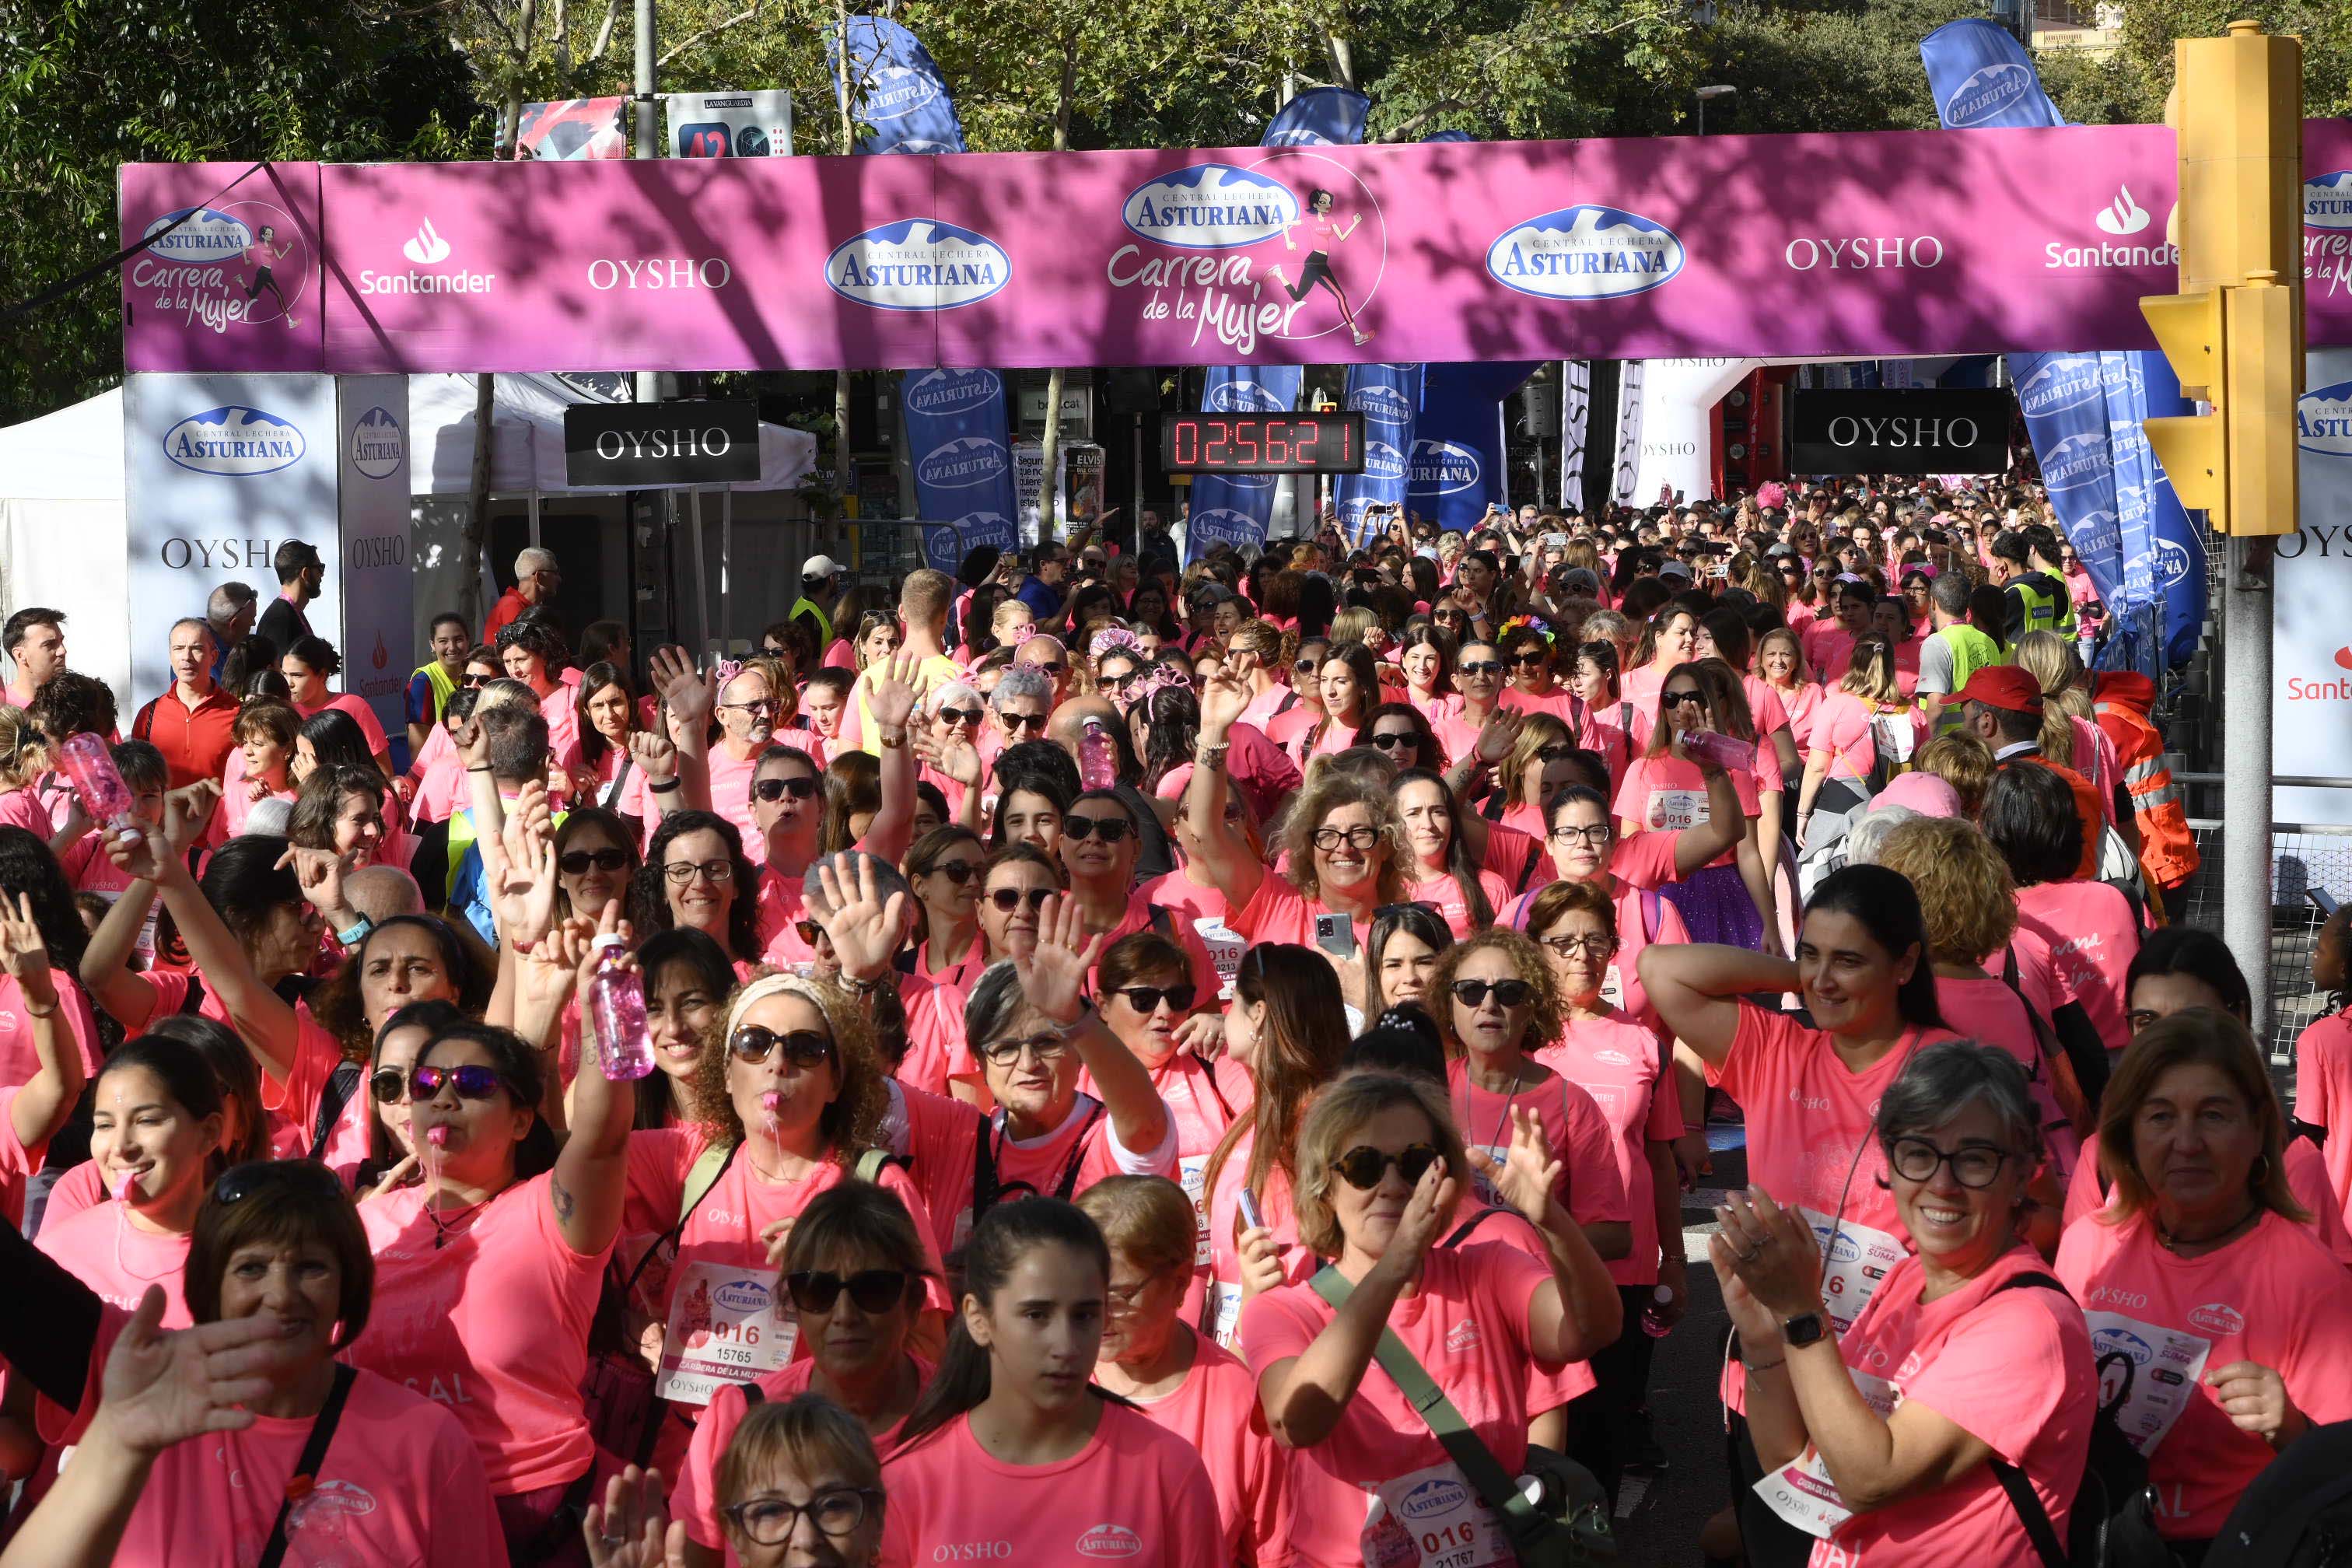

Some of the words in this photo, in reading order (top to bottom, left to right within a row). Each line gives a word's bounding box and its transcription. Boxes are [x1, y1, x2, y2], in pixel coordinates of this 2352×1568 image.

[1163, 193, 1215, 202] CENTRAL
[1221, 192, 1279, 201] LECHERA
[2304, 200, 2352, 215] STUR
[1136, 196, 1285, 227] ASTURIANA
[152, 228, 243, 250] ASTURIANA
[1532, 238, 1594, 248] CENTRAL
[1601, 236, 1663, 246] LECHERA
[2304, 234, 2352, 257] rre
[867, 250, 926, 260] CENTRAL
[932, 249, 991, 259] LECHERA
[1501, 241, 1670, 276] ASTURIANA
[1785, 236, 1944, 270] OYSHO
[133, 260, 223, 288] Carrera
[587, 258, 730, 290] OYSHO
[839, 253, 996, 287] ASTURIANA
[1108, 244, 1252, 288] Carrera
[2318, 257, 2331, 278] la
[360, 269, 495, 295] Santander
[155, 291, 173, 310] de
[176, 291, 188, 310] la
[187, 286, 258, 334] Mujer
[1143, 290, 1170, 320] de
[1176, 288, 1195, 320] la
[1191, 282, 1307, 355] Mujer
[1352, 395, 1409, 420] ASTURIANA
[596, 427, 731, 460] OYSHO
[1175, 422, 1349, 464] 02:56:21
[1828, 416, 1979, 448] OYSHO
[174, 431, 296, 459] ASTURIANA
[355, 436, 401, 461] ASTURIANA
[1643, 442, 1696, 456] YSHO
[1076, 455, 1101, 464] ELVIS
[1020, 498, 1035, 506] este
[1196, 517, 1260, 544] ASTURIANA
[353, 535, 404, 569] OYSHO
[359, 675, 403, 698] Santander
[1668, 814, 1692, 824] 016
[1209, 947, 1238, 961] 016
[1867, 1248, 1896, 1263] SUMA
[719, 1293, 767, 1307] ASTURIANA
[715, 1321, 760, 1346] 016
[2193, 1311, 2242, 1332] ASTURIANA
[717, 1348, 751, 1363] 15765
[678, 1361, 716, 1374] CARRERA
[717, 1367, 727, 1375] DE
[740, 1370, 768, 1380] MUJE
[670, 1379, 714, 1395] OYSHO
[1406, 1489, 1465, 1515] ASTURIANA
[1081, 1538, 1136, 1551] ASTURIANA
[1422, 1521, 1475, 1554] 016
[933, 1540, 1013, 1563] OYSHO
